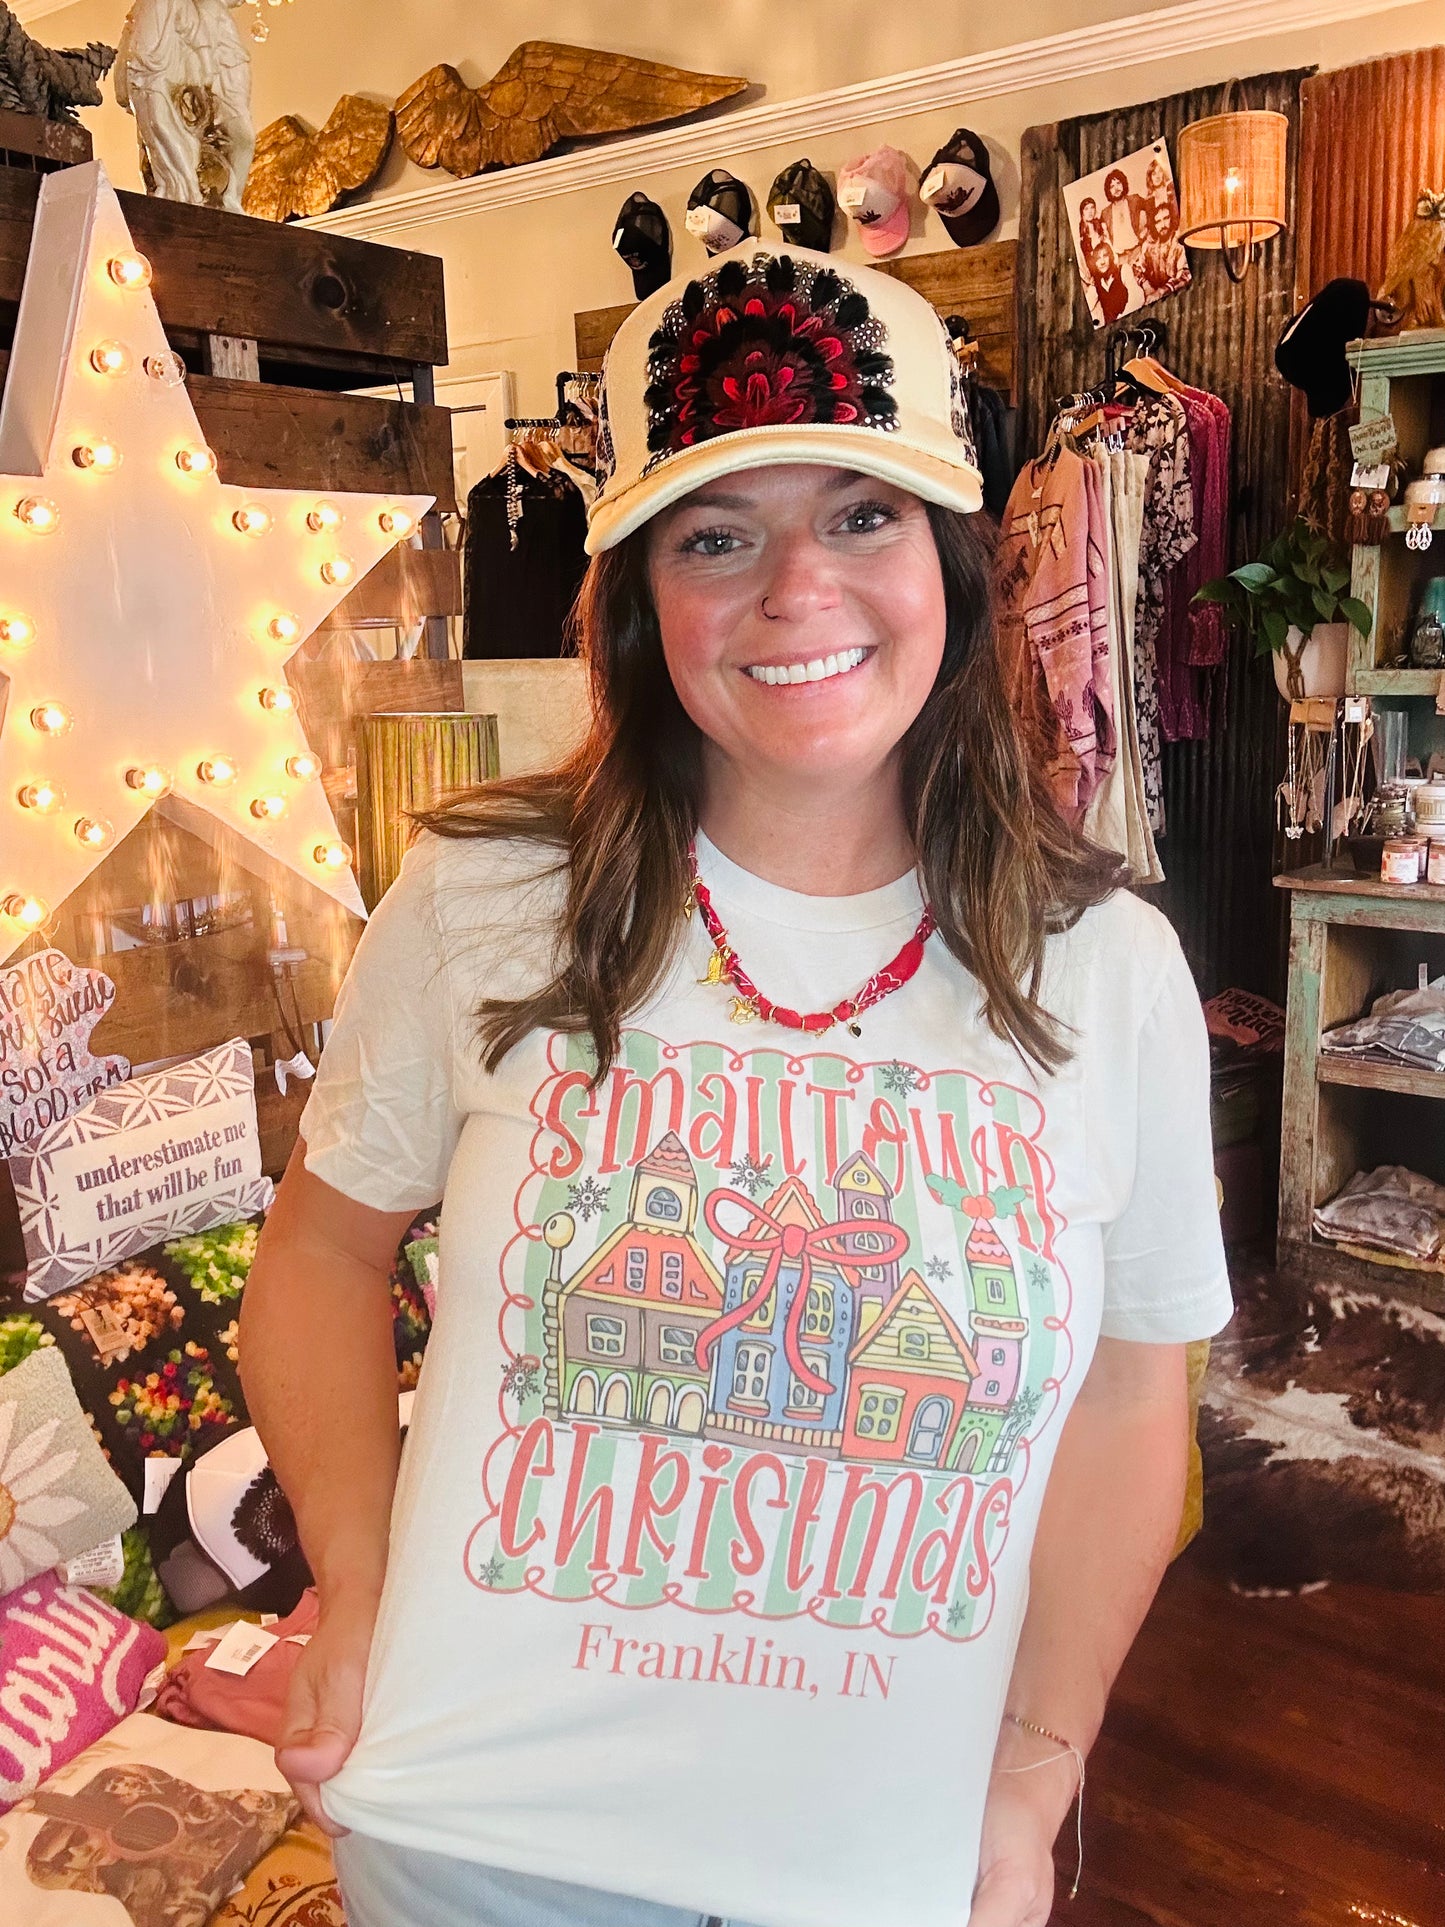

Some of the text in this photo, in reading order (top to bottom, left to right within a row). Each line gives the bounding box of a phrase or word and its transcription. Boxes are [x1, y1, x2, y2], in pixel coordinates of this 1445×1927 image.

[75, 1120, 247, 1192] underestimate me
[96, 1156, 243, 1222] that will be fun
[571, 1622, 900, 1701] Franklin, IN
